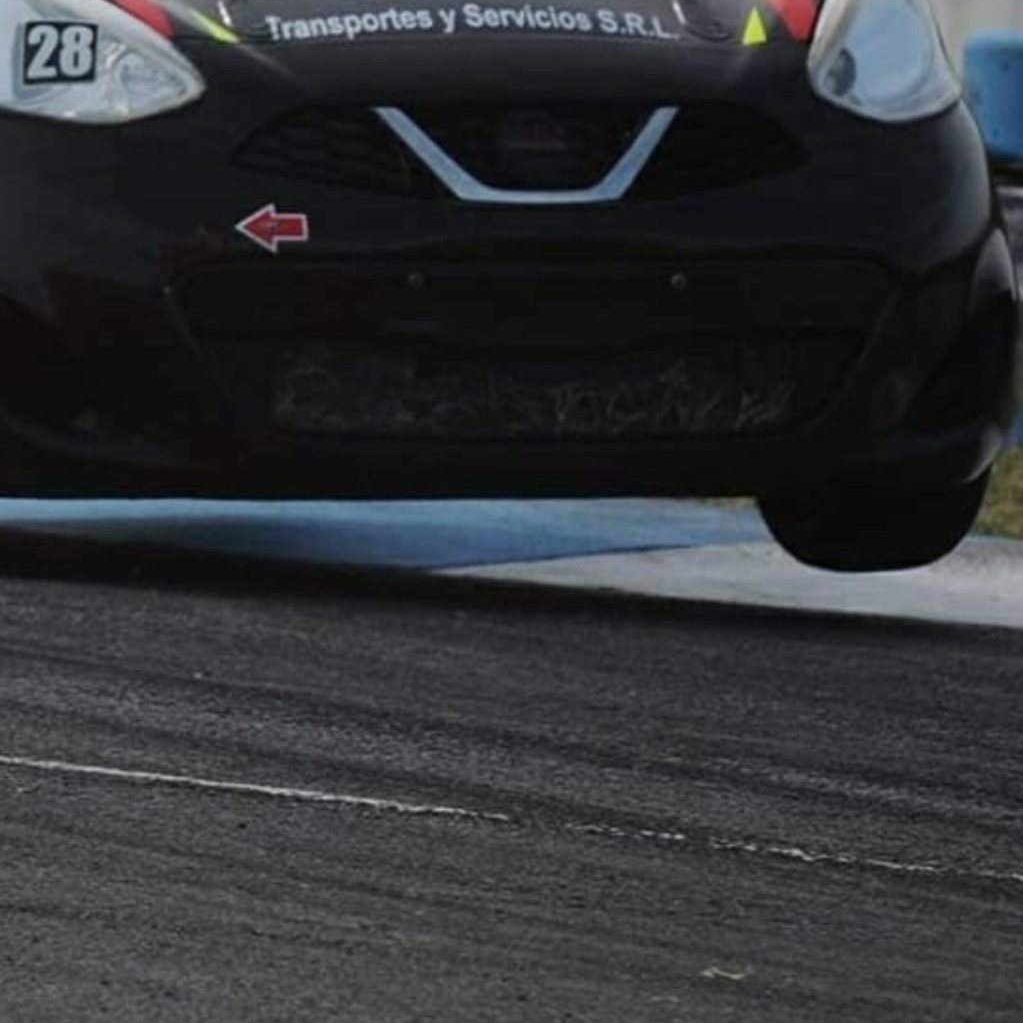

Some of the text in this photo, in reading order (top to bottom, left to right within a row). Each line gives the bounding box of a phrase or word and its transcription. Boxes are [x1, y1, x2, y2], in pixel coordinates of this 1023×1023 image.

[264, 7, 434, 42] Transportes
[437, 8, 457, 34] y
[461, 2, 594, 33] Servicios
[26, 24, 95, 80] 28
